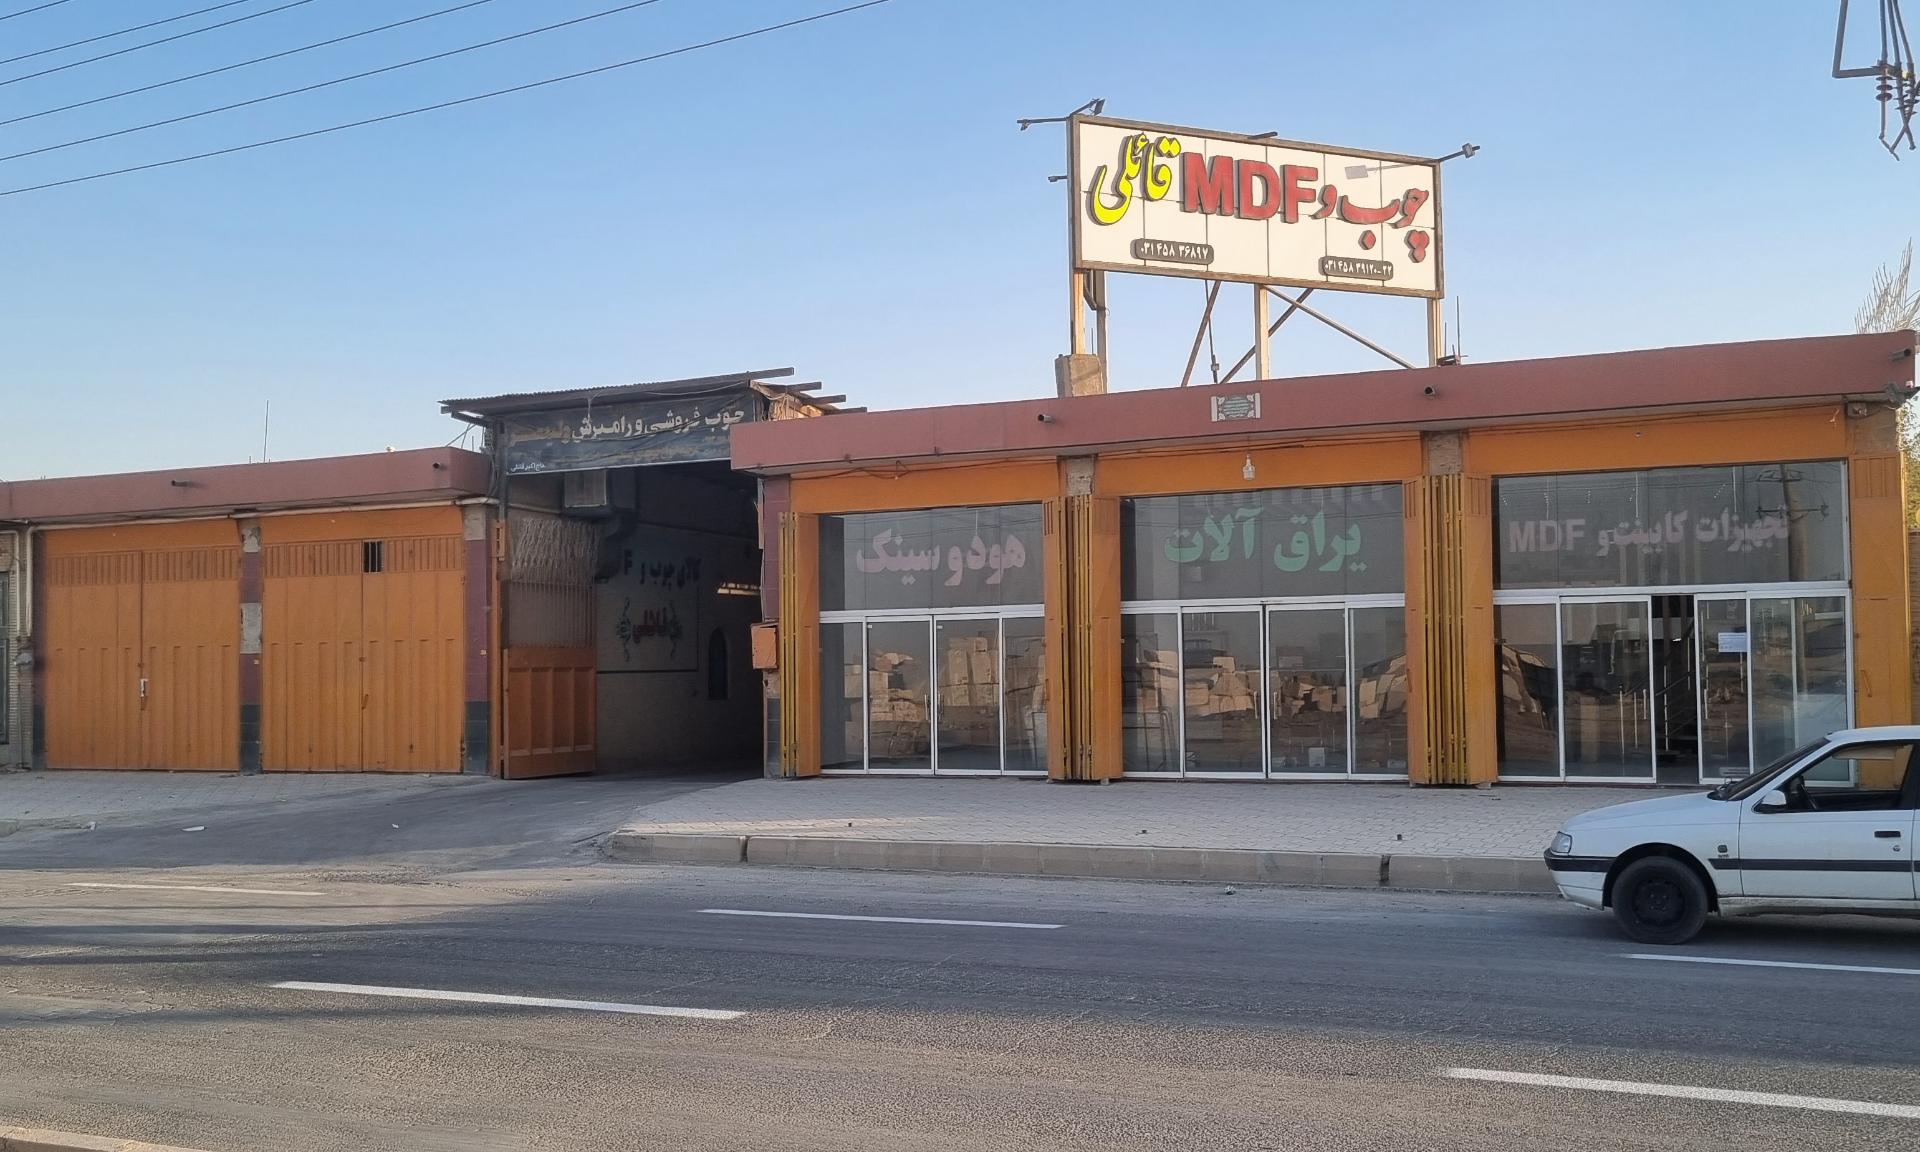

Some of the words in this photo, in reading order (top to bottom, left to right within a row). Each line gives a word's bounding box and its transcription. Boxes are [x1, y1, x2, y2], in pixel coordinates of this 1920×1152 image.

[1181, 151, 1319, 224] MDF
[1312, 184, 1338, 219] و
[1340, 187, 1430, 263] چوب
[1164, 505, 1264, 564] آلات
[1273, 511, 1367, 573] یراق
[1509, 519, 1586, 553] MDF
[1596, 529, 1609, 558] و
[1614, 510, 1689, 554] کابینت
[1695, 504, 1790, 552] تجهیزات
[856, 528, 940, 586] سینک
